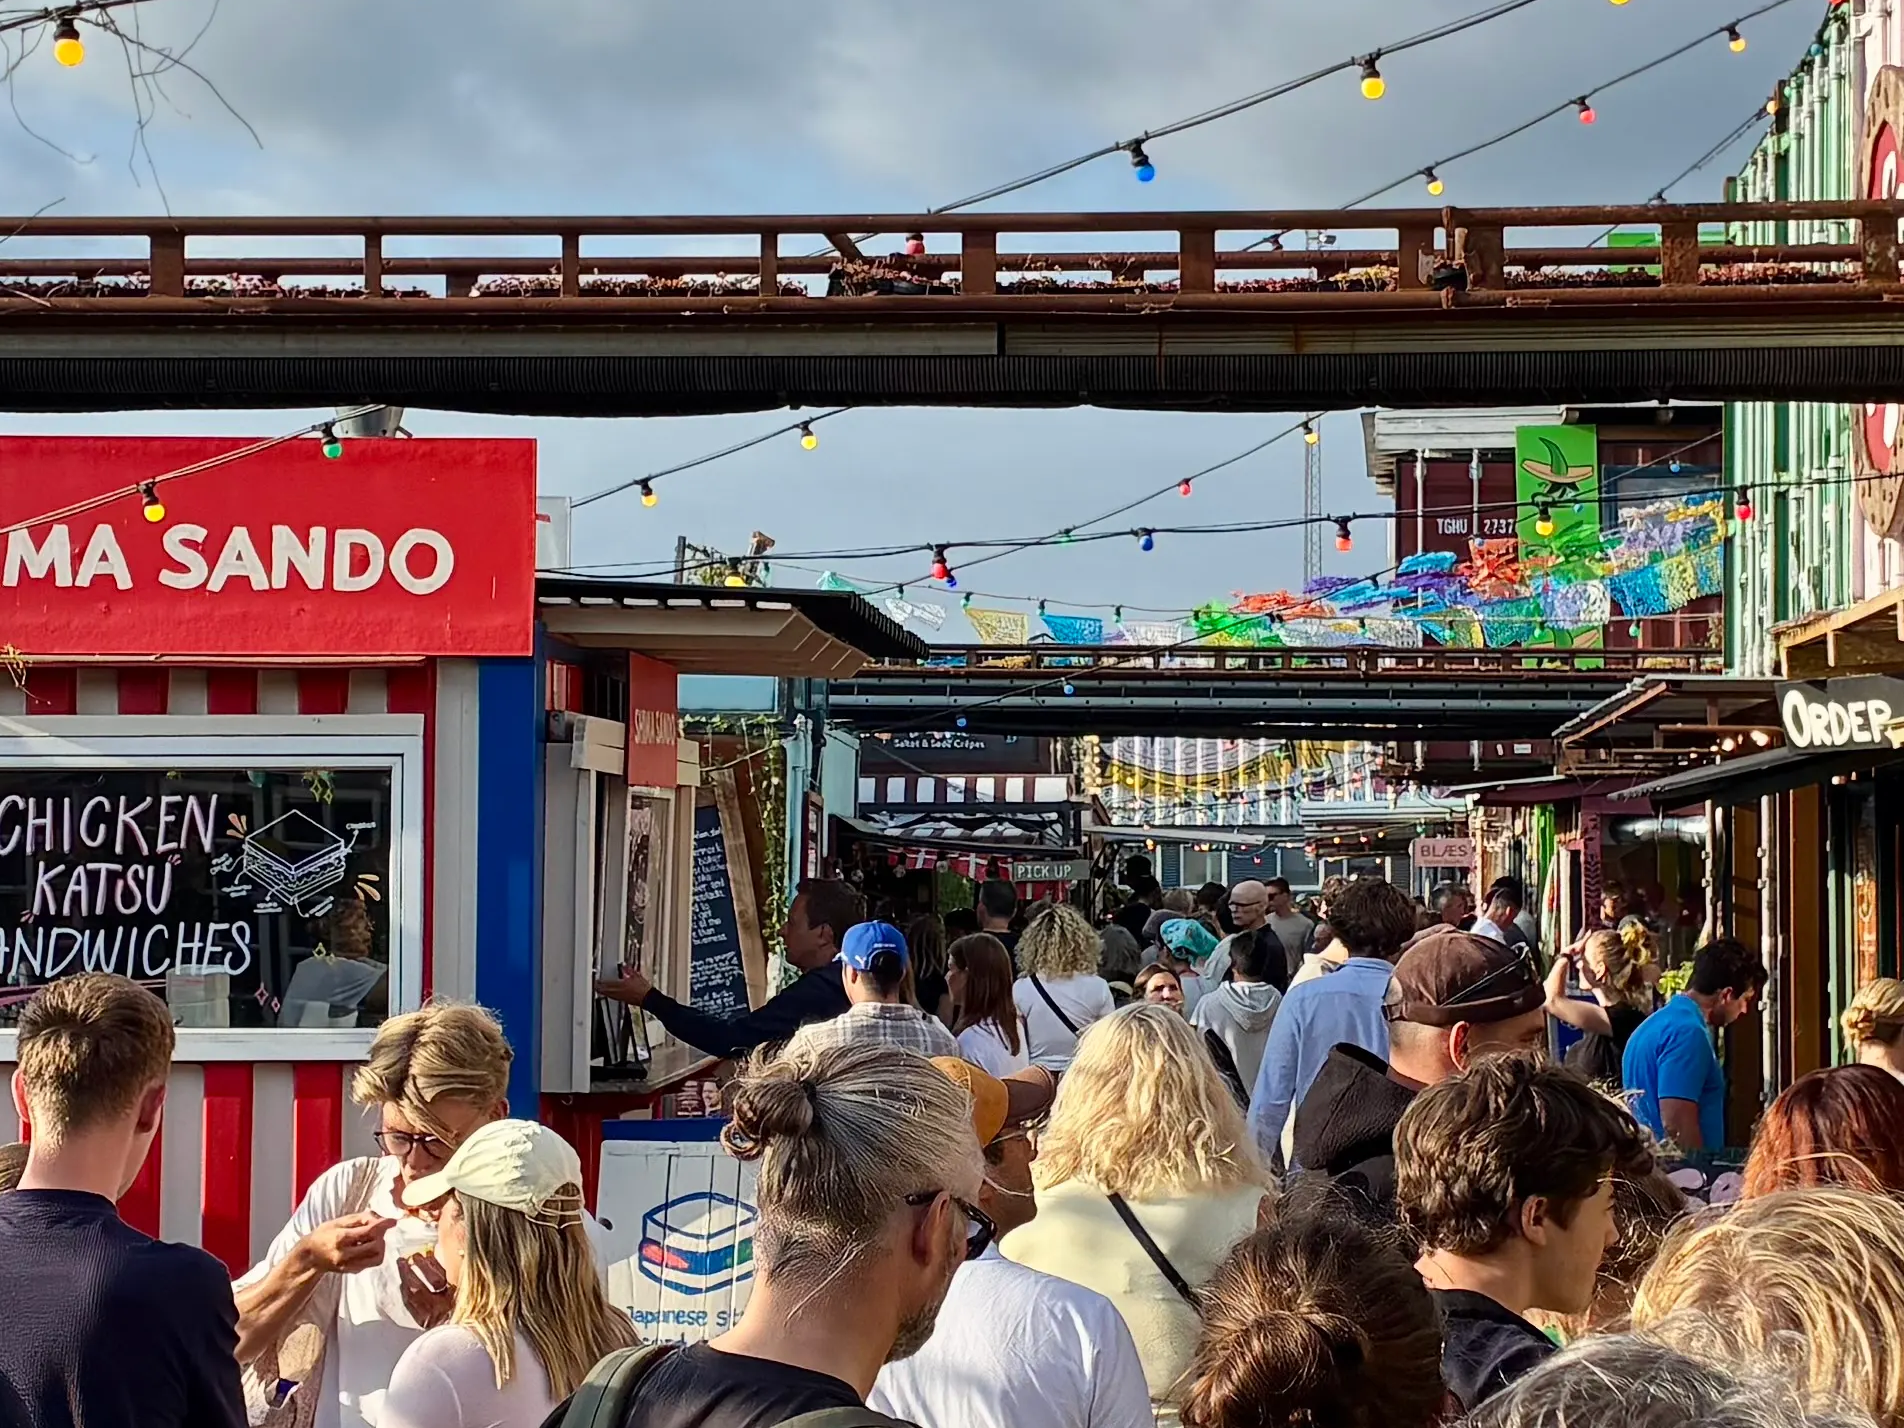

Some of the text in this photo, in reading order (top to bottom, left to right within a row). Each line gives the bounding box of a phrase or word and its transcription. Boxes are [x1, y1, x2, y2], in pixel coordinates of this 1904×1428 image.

[158, 523, 455, 595] SANDO
[1783, 689, 1893, 749] ORDER
[32, 861, 173, 916] KATSU
[1017, 864, 1072, 878] PICK UP
[626, 1306, 708, 1329] Japanese
